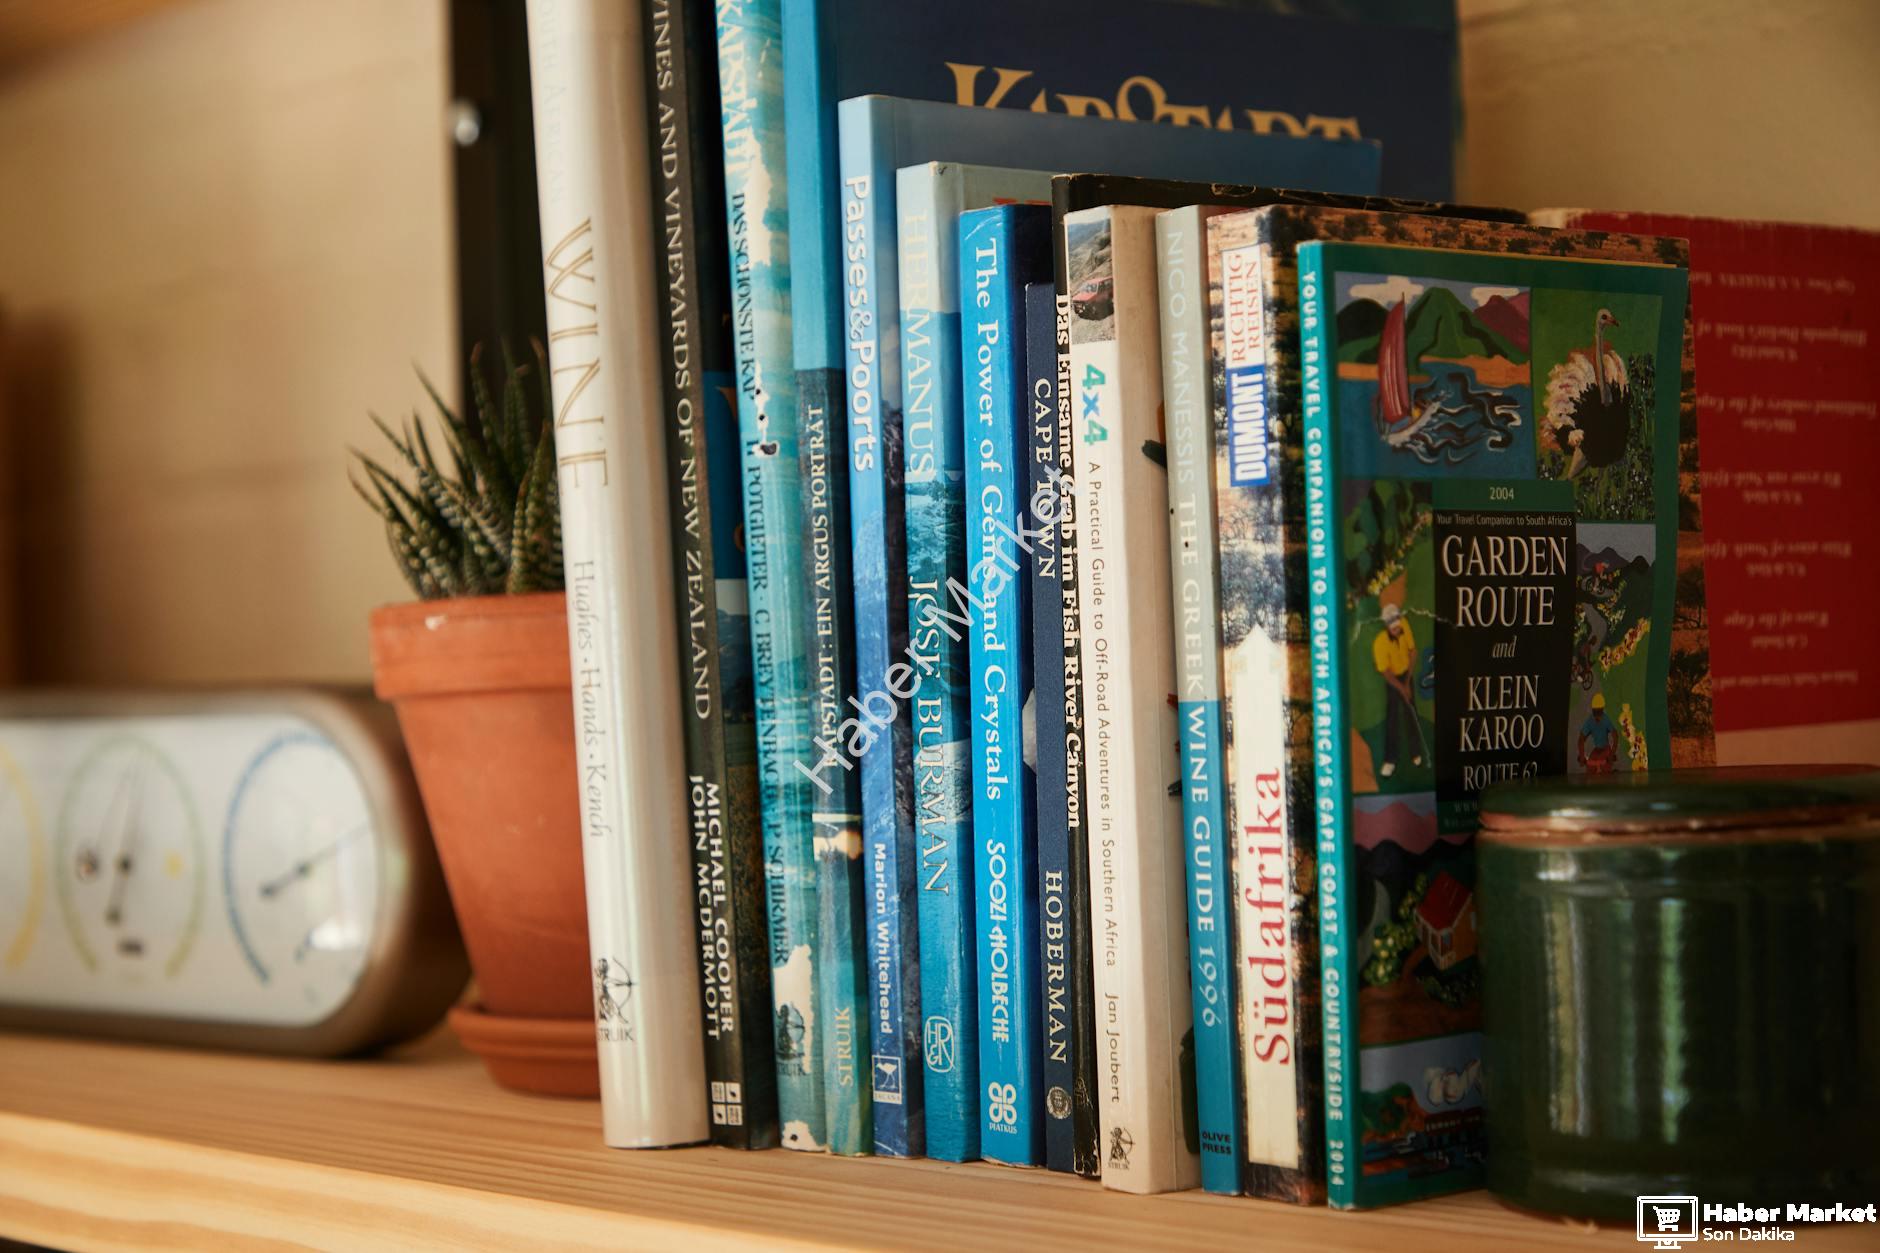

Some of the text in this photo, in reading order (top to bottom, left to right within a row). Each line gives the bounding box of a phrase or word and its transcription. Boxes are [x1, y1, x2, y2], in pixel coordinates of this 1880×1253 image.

[658, 102, 678, 180] AND
[732, 193, 748, 235] DAS
[664, 187, 691, 390] VINEYARDS
[974, 237, 998, 309] The
[1229, 252, 1247, 363] RICHTIG
[1247, 261, 1260, 350] REISEN
[1302, 271, 1318, 331] YOUR
[545, 217, 607, 489] WINE
[845, 174, 877, 474] Passes&Poorts
[902, 209, 935, 483] HERMANUS
[978, 320, 999, 428] Power
[1082, 363, 1108, 446] 4x4
[1305, 337, 1321, 418] TRAVEL
[676, 398, 694, 453] OF
[806, 405, 828, 508] PORTRÄT
[979, 438, 1002, 473] of
[1231, 372, 1267, 481] DUMONT
[680, 464, 700, 540] NEW
[1034, 378, 1055, 579] CAPE TOWN
[1307, 427, 1326, 558] COMPANION
[1436, 513, 1572, 527] Your Travel Companion to South Africa's
[1490, 487, 1514, 500] 2004
[812, 514, 831, 591] ARGUS
[1313, 566, 1326, 596] TO
[1442, 534, 1568, 577] GARDEN
[573, 560, 599, 650] Hughes
[686, 550, 712, 720] ZEALAND
[815, 597, 832, 636] EIN
[983, 591, 1006, 652] and
[1168, 231, 1222, 1028] NICO MANESSIS THE GREEK WINE GUIDE 1996
[1313, 604, 1329, 679] SOUTH
[1456, 586, 1555, 627] ROUTE
[1492, 635, 1517, 658] and
[580, 668, 606, 747] Hands
[984, 665, 1010, 801] Crystals
[1088, 461, 1118, 966] A Practical Guide to Off-Road Adventures in Southern Africa
[1459, 713, 1544, 752] KAROO
[1468, 674, 1540, 711] KLEIN
[1317, 687, 1333, 788] AFRICA'S
[916, 697, 949, 896] BURMAN
[1066, 732, 1080, 831] Canyon
[1320, 797, 1335, 853] CAPE
[689, 775, 720, 1040] JOHN MCDERMOTT
[705, 782, 735, 1033] MICHAEL COOPER
[986, 839, 1007, 922] SOOZI
[1244, 767, 1290, 1065] Südafrika
[1321, 863, 1337, 934] COAST
[873, 843, 893, 1034] Marion Whitehead
[1045, 870, 1067, 1065] HOBERMAN
[834, 1007, 853, 1088] STRUIK
[1104, 992, 1121, 1103] Jan Joubert
[1325, 967, 1343, 1121] COUNTRYSIDE
[1202, 1131, 1231, 1143] OLIVE
[1202, 1142, 1232, 1155] PRESS
[1329, 1140, 1344, 1185] 2004
